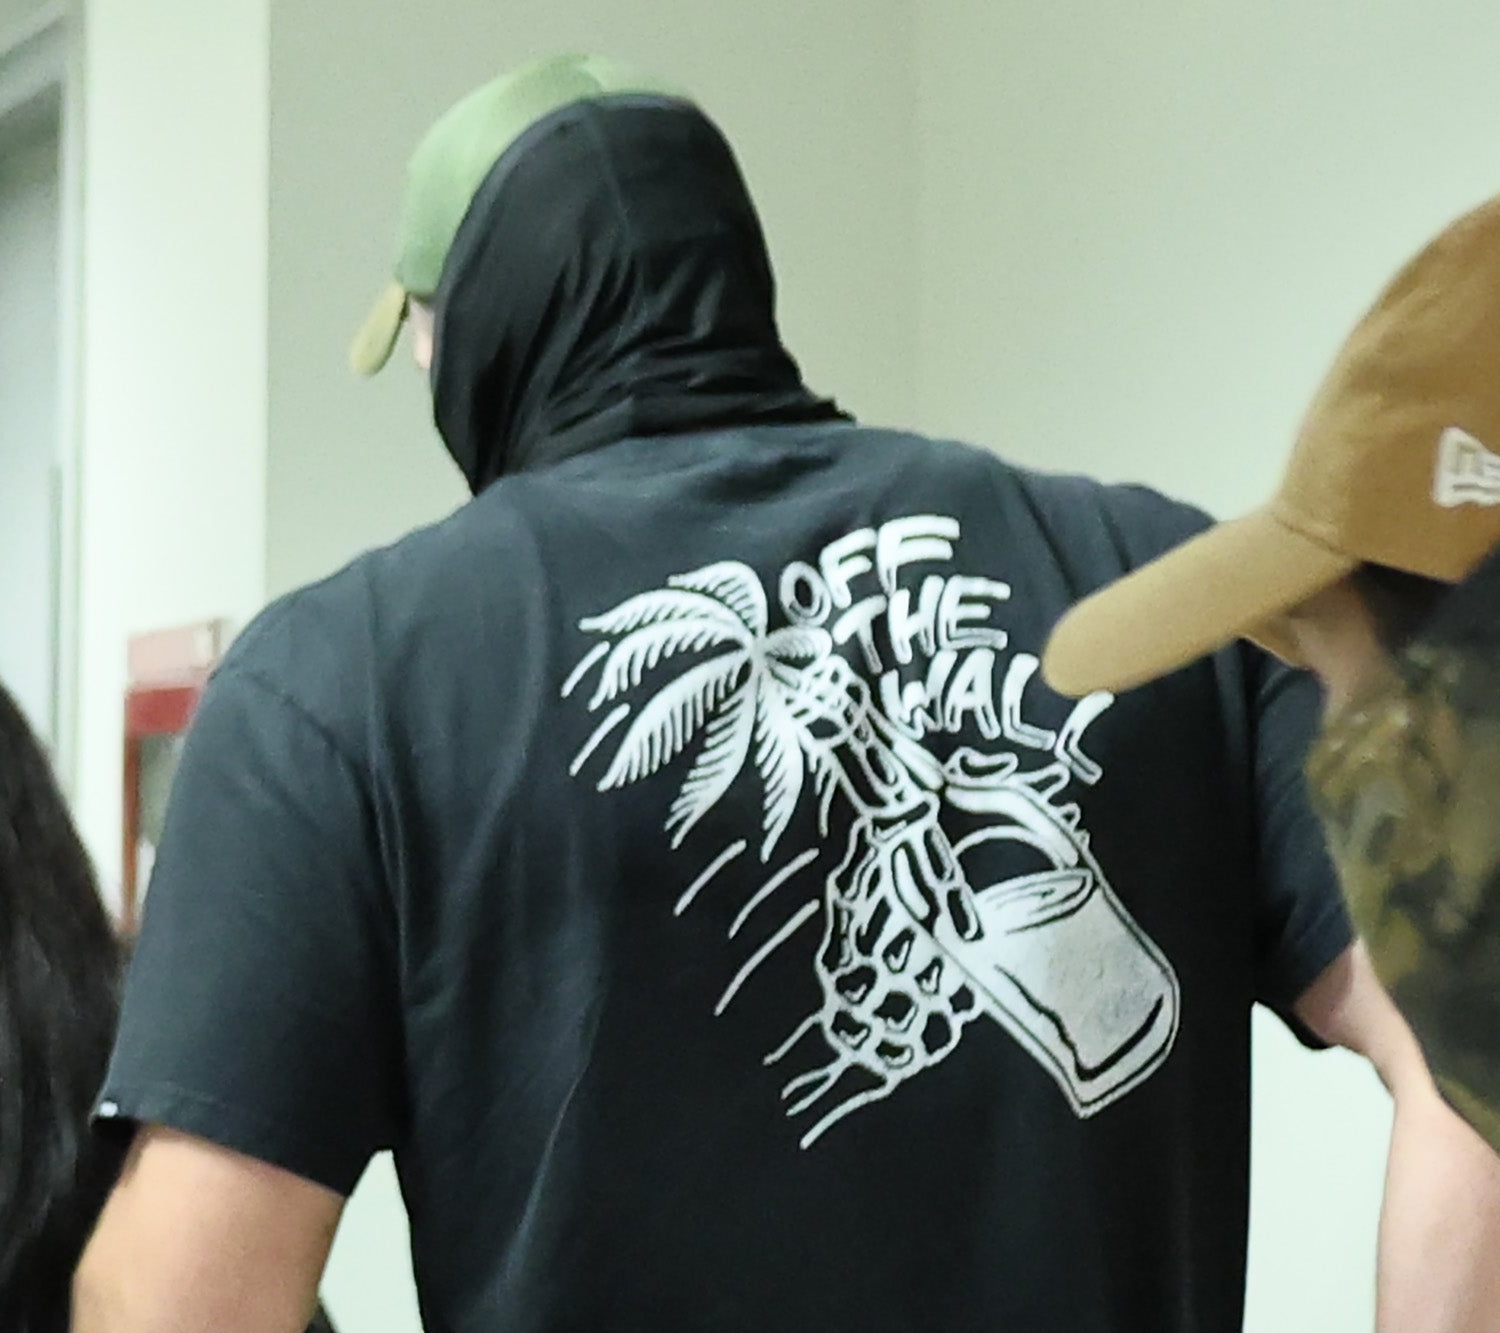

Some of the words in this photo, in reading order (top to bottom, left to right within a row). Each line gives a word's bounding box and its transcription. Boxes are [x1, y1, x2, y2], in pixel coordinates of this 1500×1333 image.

[779, 515, 960, 627] OFF
[832, 574, 1011, 674] THE
[880, 648, 1115, 785] WALL
